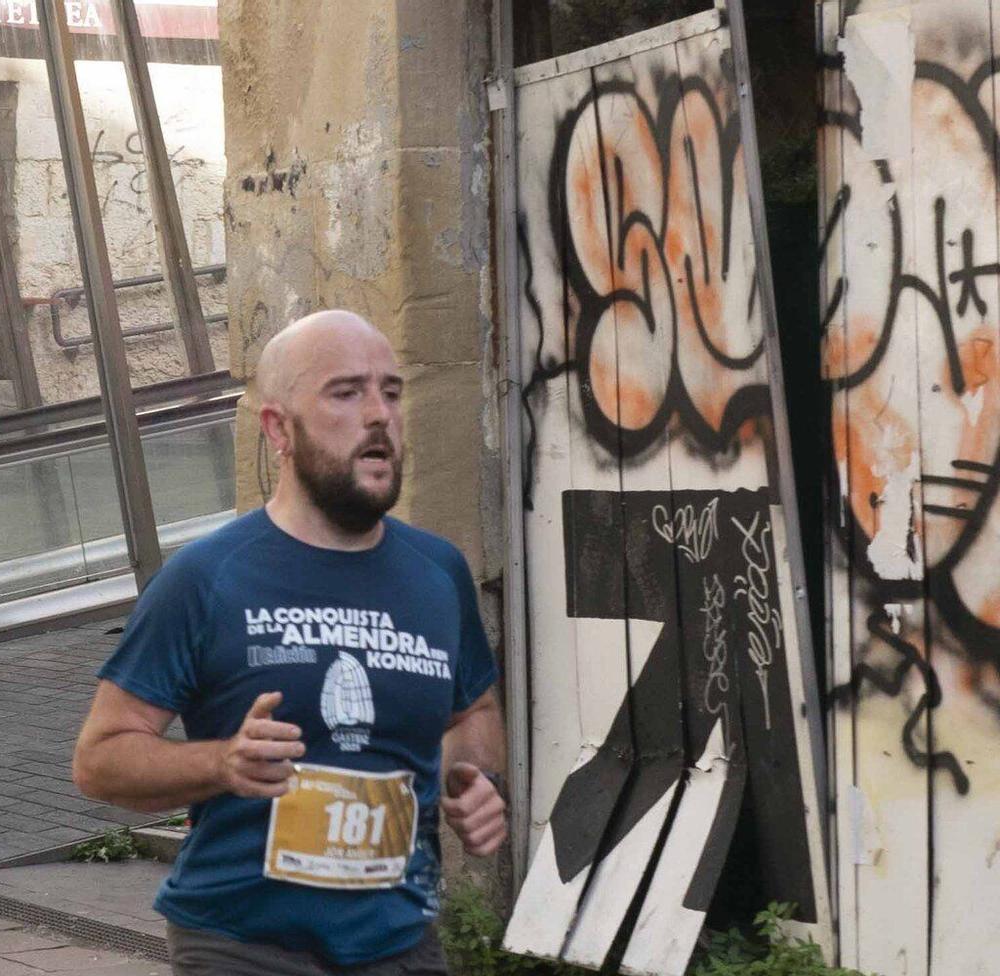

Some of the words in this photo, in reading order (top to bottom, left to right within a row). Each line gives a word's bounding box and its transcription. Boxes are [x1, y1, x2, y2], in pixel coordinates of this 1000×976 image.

[245, 607, 273, 624] LA
[273, 607, 395, 630] CONQUISTA
[247, 625, 266, 636] DE
[266, 623, 285, 634] LA
[281, 624, 430, 659] ALMENDRA
[366, 651, 452, 680] KONKISTA
[324, 800, 387, 846] 181
